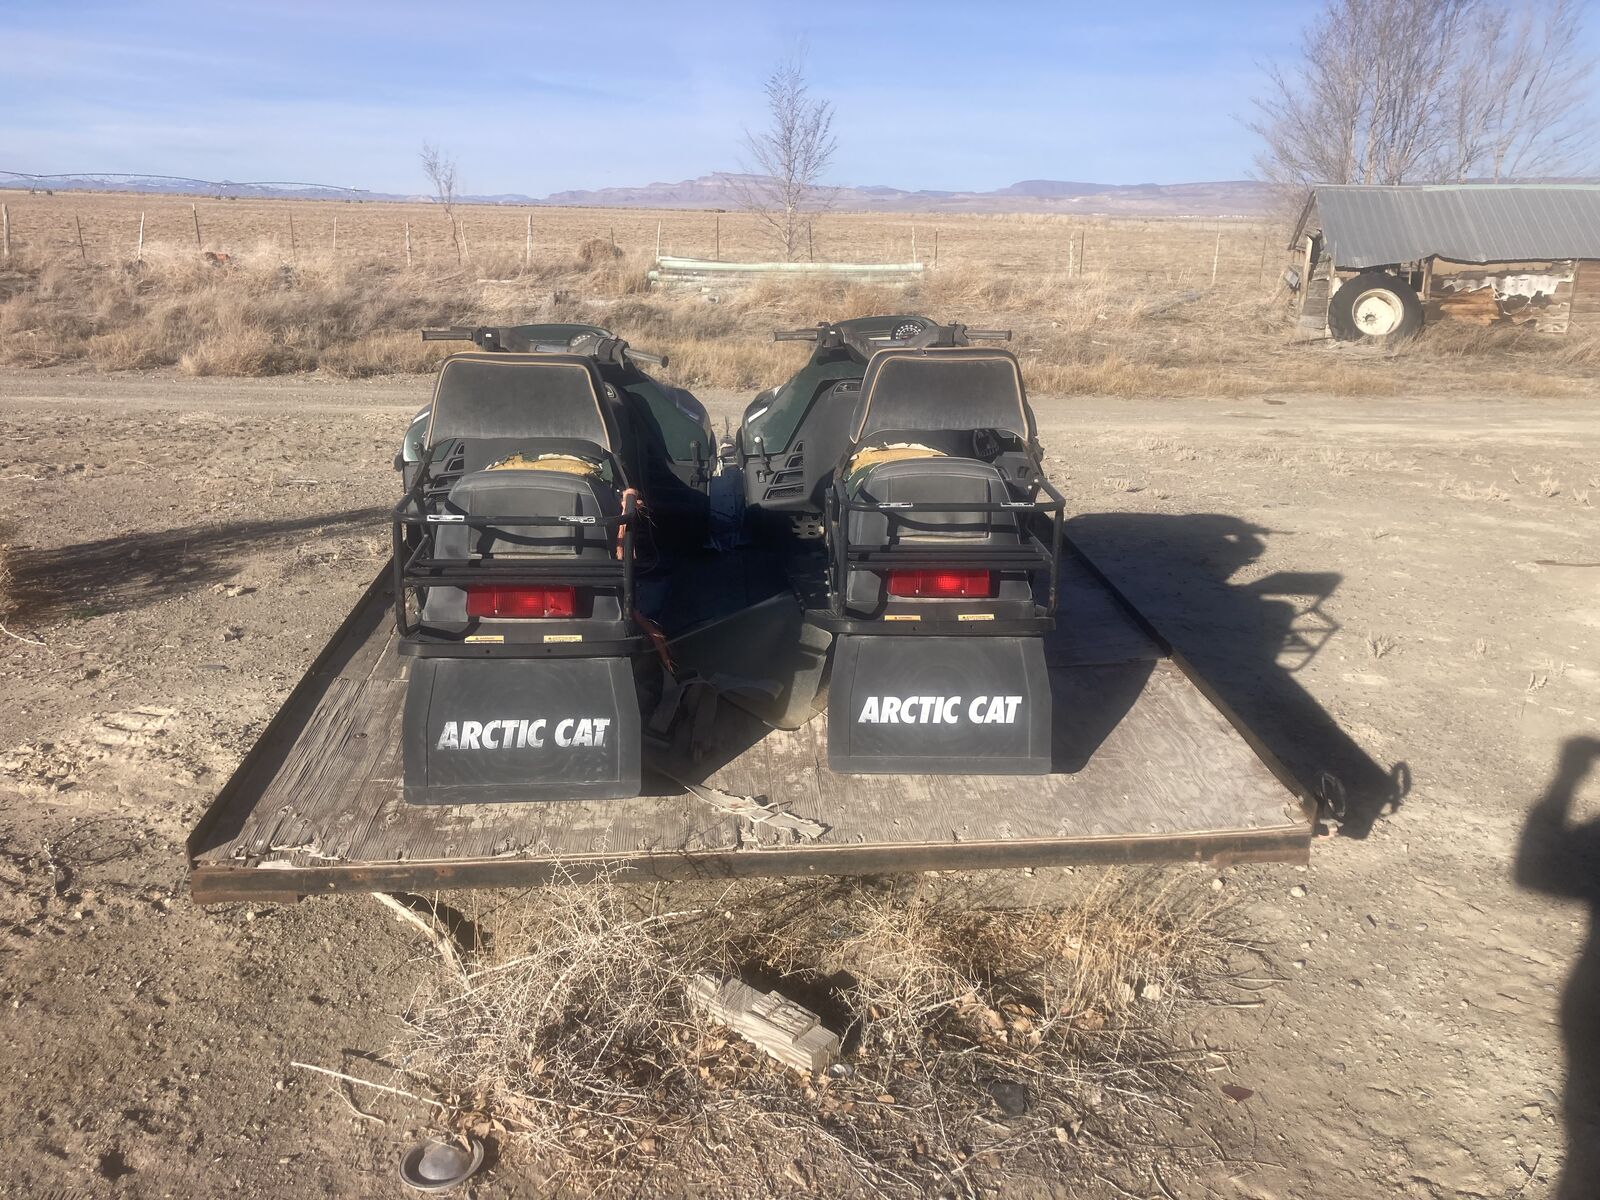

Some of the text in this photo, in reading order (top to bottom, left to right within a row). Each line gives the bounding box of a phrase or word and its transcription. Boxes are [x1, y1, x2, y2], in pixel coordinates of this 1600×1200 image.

[858, 695, 1023, 724] ARCTIC CAT
[437, 718, 611, 750] ARCTIC CAT
